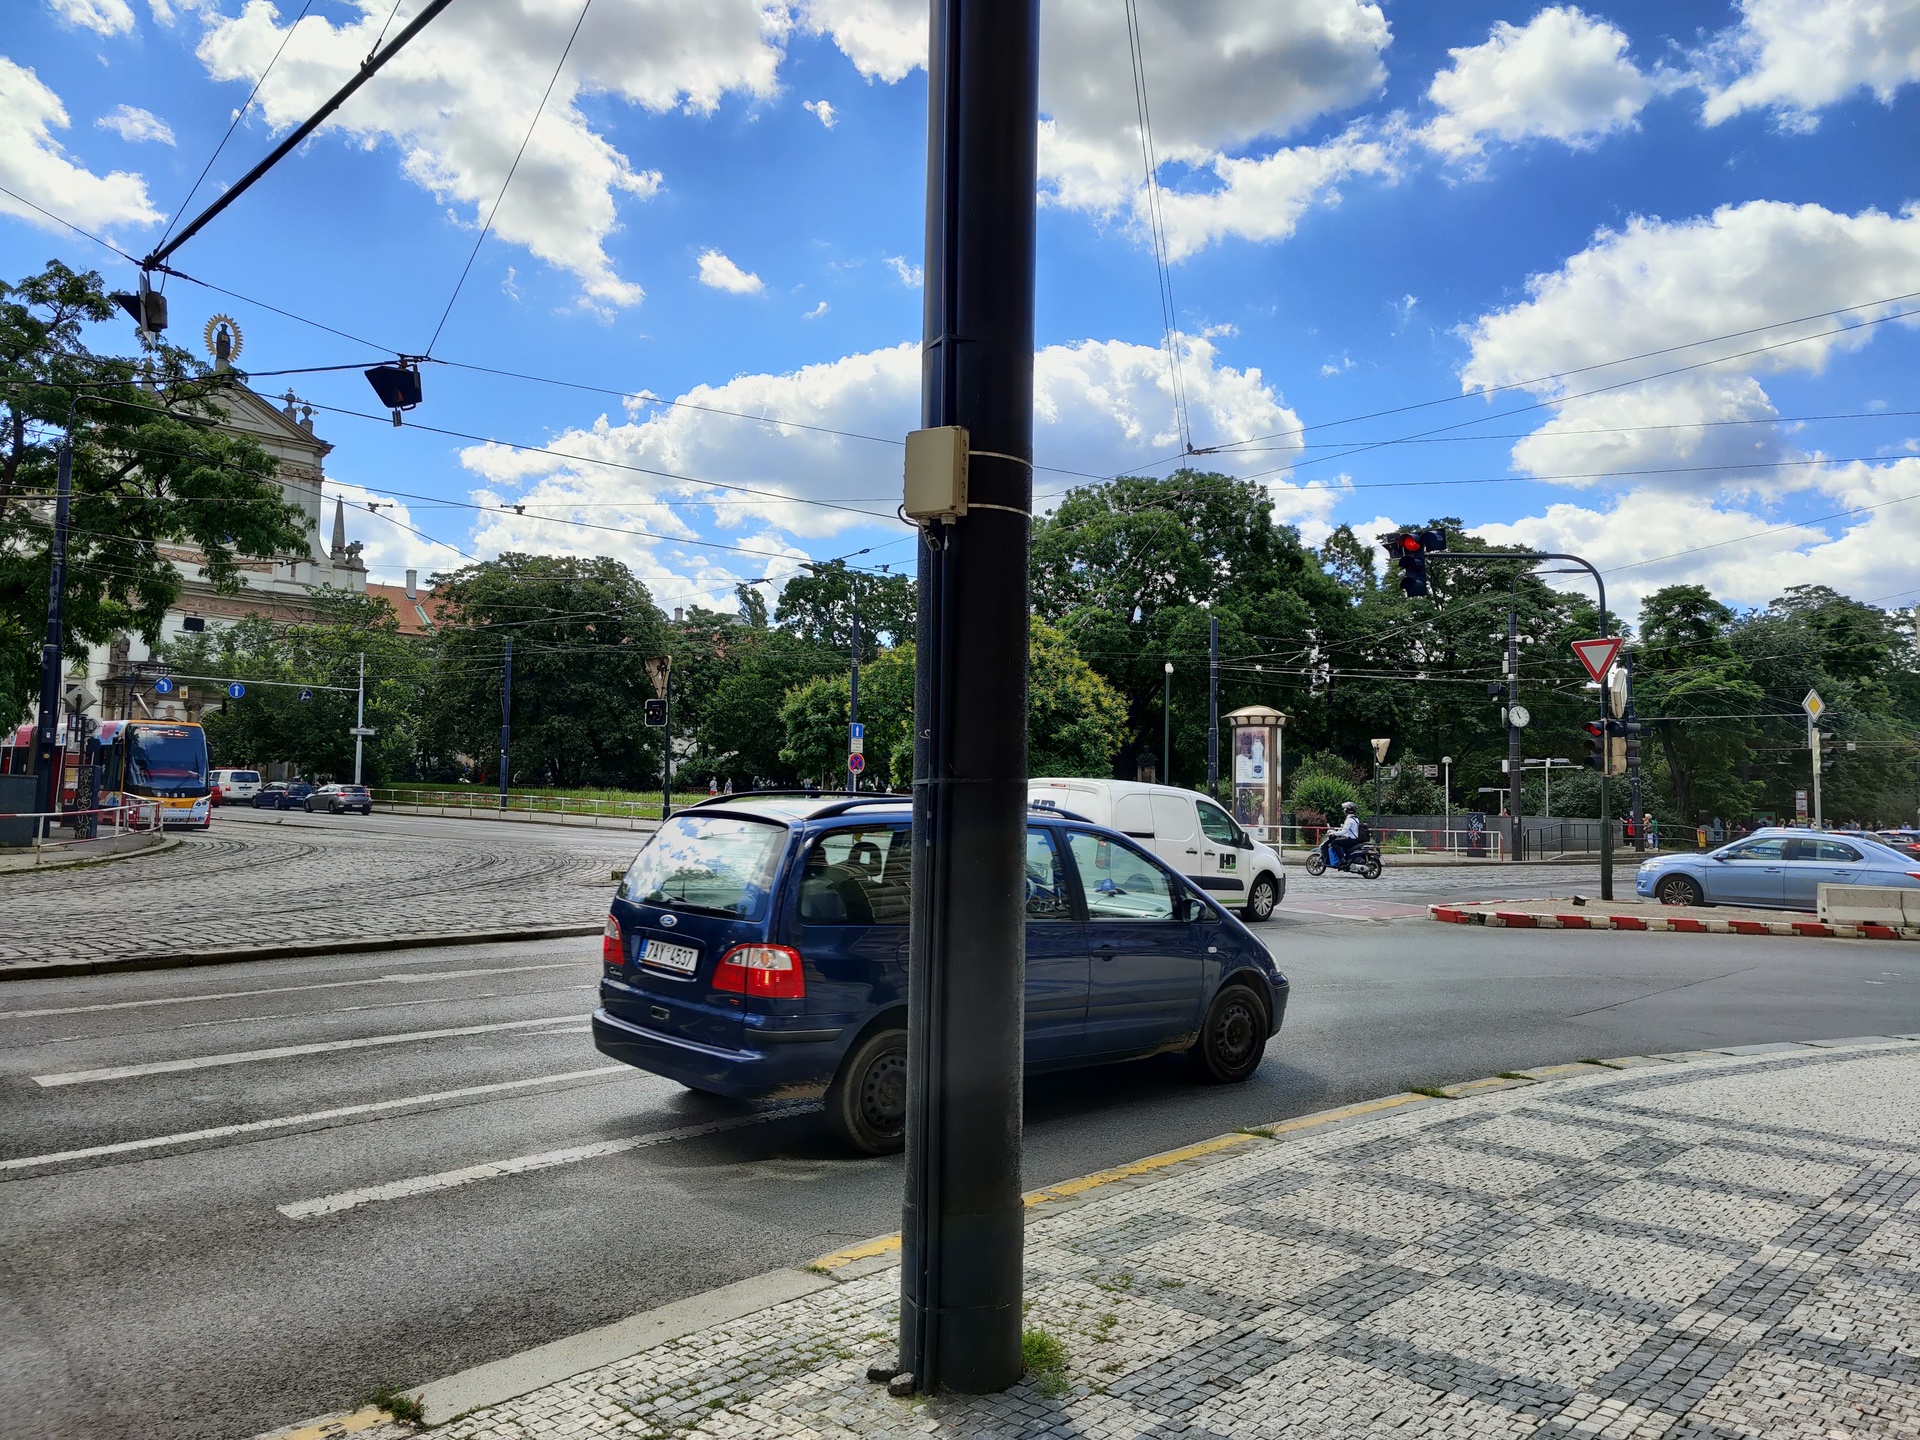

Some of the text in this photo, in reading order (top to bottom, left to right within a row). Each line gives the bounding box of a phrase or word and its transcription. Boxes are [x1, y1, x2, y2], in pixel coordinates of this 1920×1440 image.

[1219, 853, 1237, 870] HD
[646, 942, 694, 968] 7AY 4537
